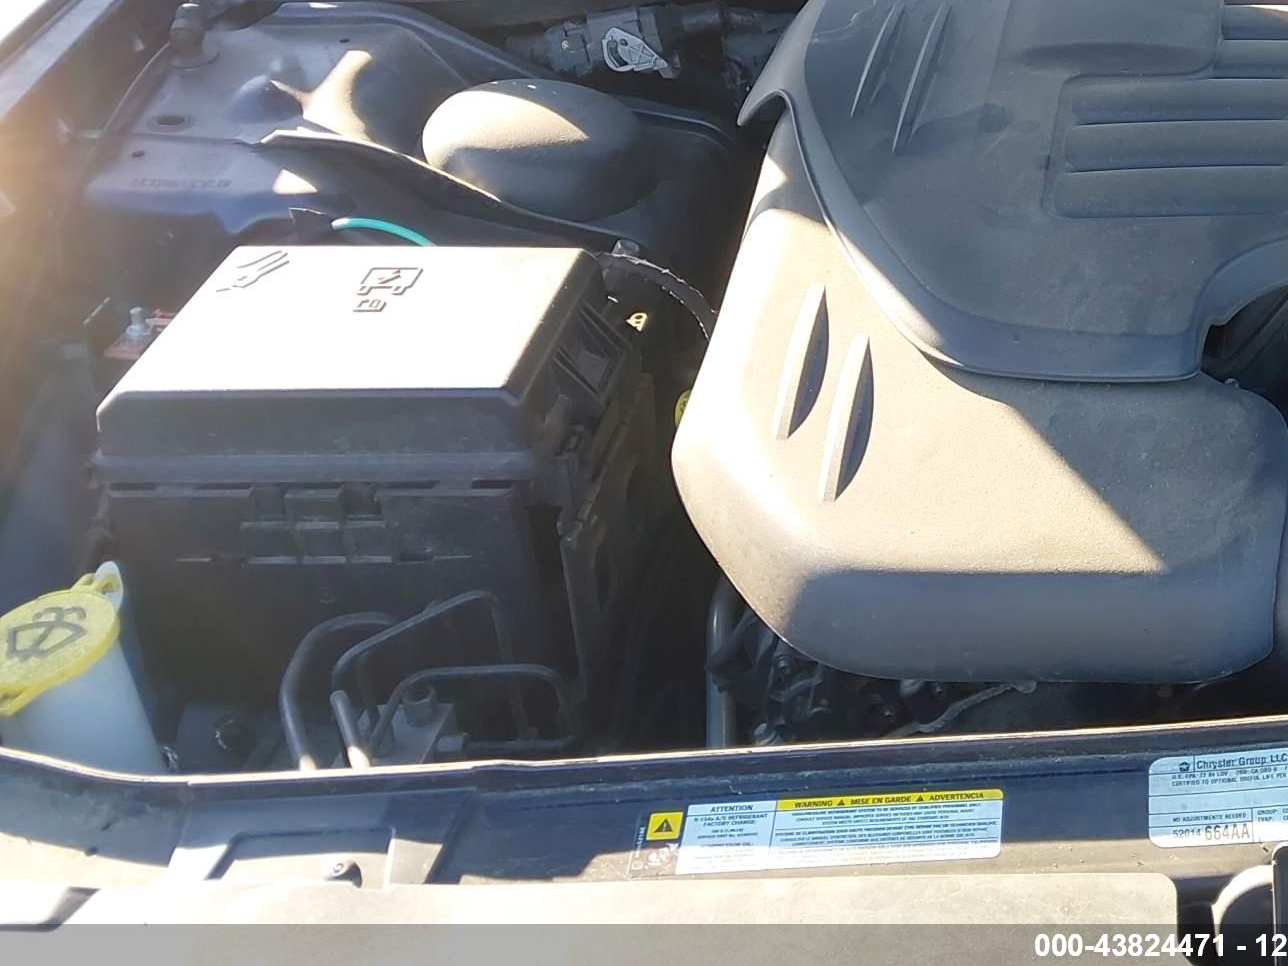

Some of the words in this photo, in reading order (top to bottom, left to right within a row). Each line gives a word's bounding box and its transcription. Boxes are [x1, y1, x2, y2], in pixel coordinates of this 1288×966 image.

[1196, 758, 1235, 770] Chrysler
[1238, 755, 1267, 766] Group
[1270, 753, 1288, 762] LLC
[850, 797, 869, 805] MISE
[884, 795, 911, 803] GARDE
[929, 792, 984, 801] ADVERTENCIA
[710, 805, 754, 813] ATTENTION
[728, 813, 768, 821] REFRIGERANT
[1182, 814, 1223, 822] ADJUSTMENTS
[1173, 828, 1202, 838] 52014
[1204, 823, 1250, 840] 664AA
